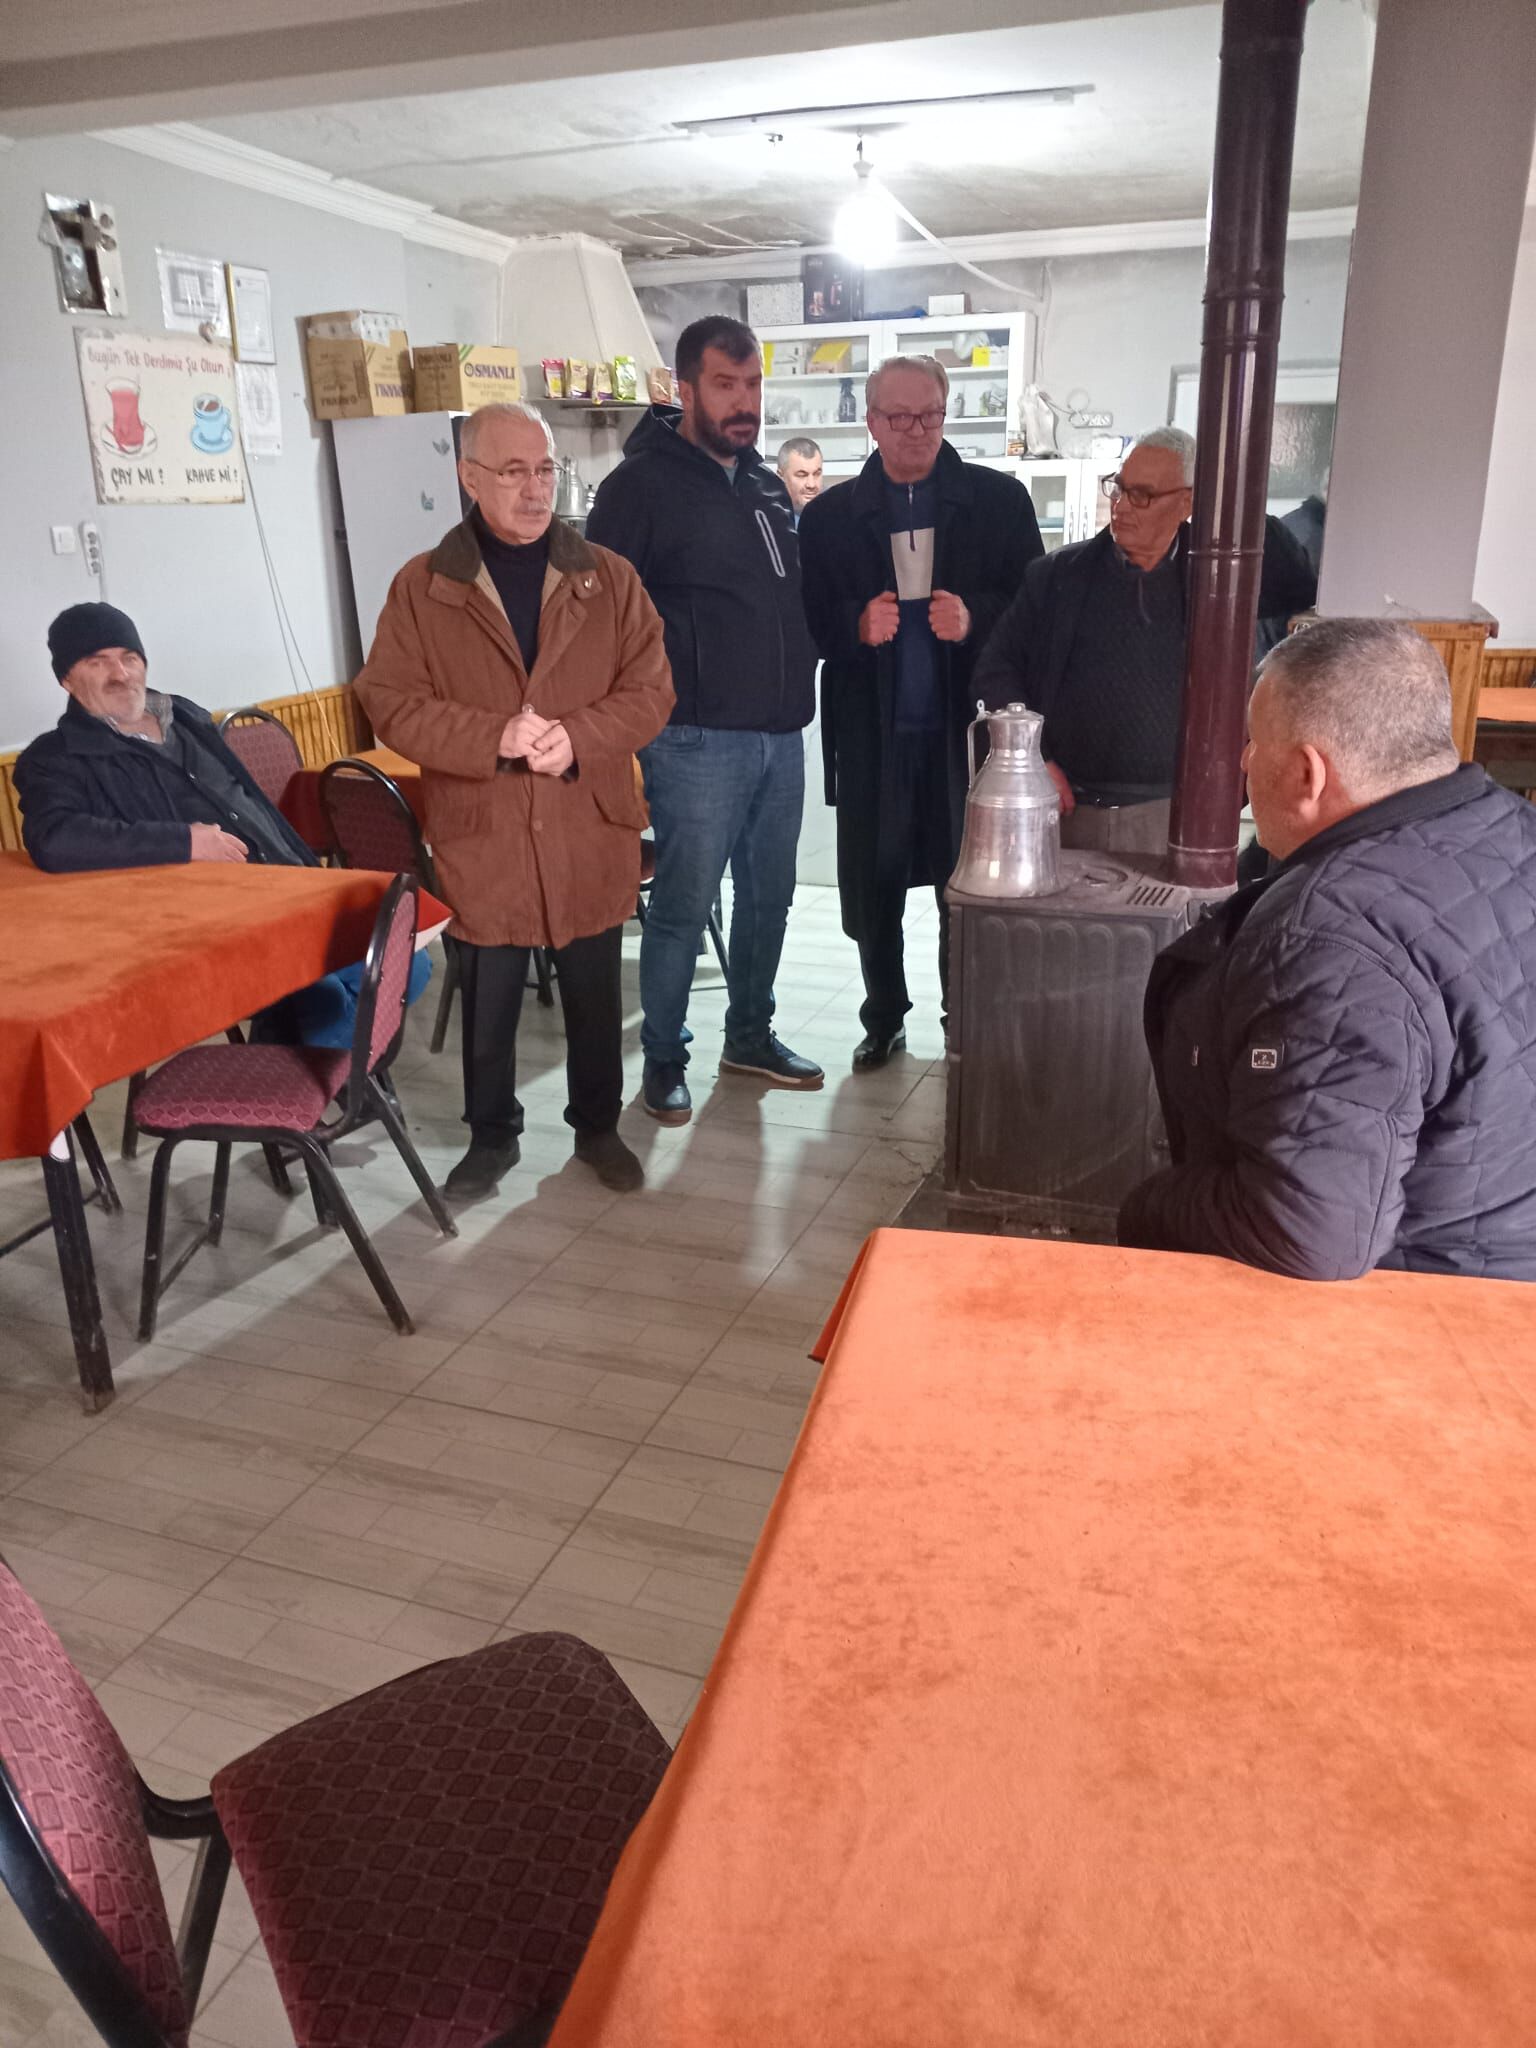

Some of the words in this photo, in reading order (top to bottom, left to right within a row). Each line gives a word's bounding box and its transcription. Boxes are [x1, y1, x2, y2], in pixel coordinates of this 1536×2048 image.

[124, 349, 140, 367] Tek
[143, 352, 182, 371] Derdimiz
[464, 362, 516, 380] OSMANLI
[111, 467, 132, 491] ÇAY
[138, 467, 154, 485] MI
[185, 468, 215, 484] KAHVE
